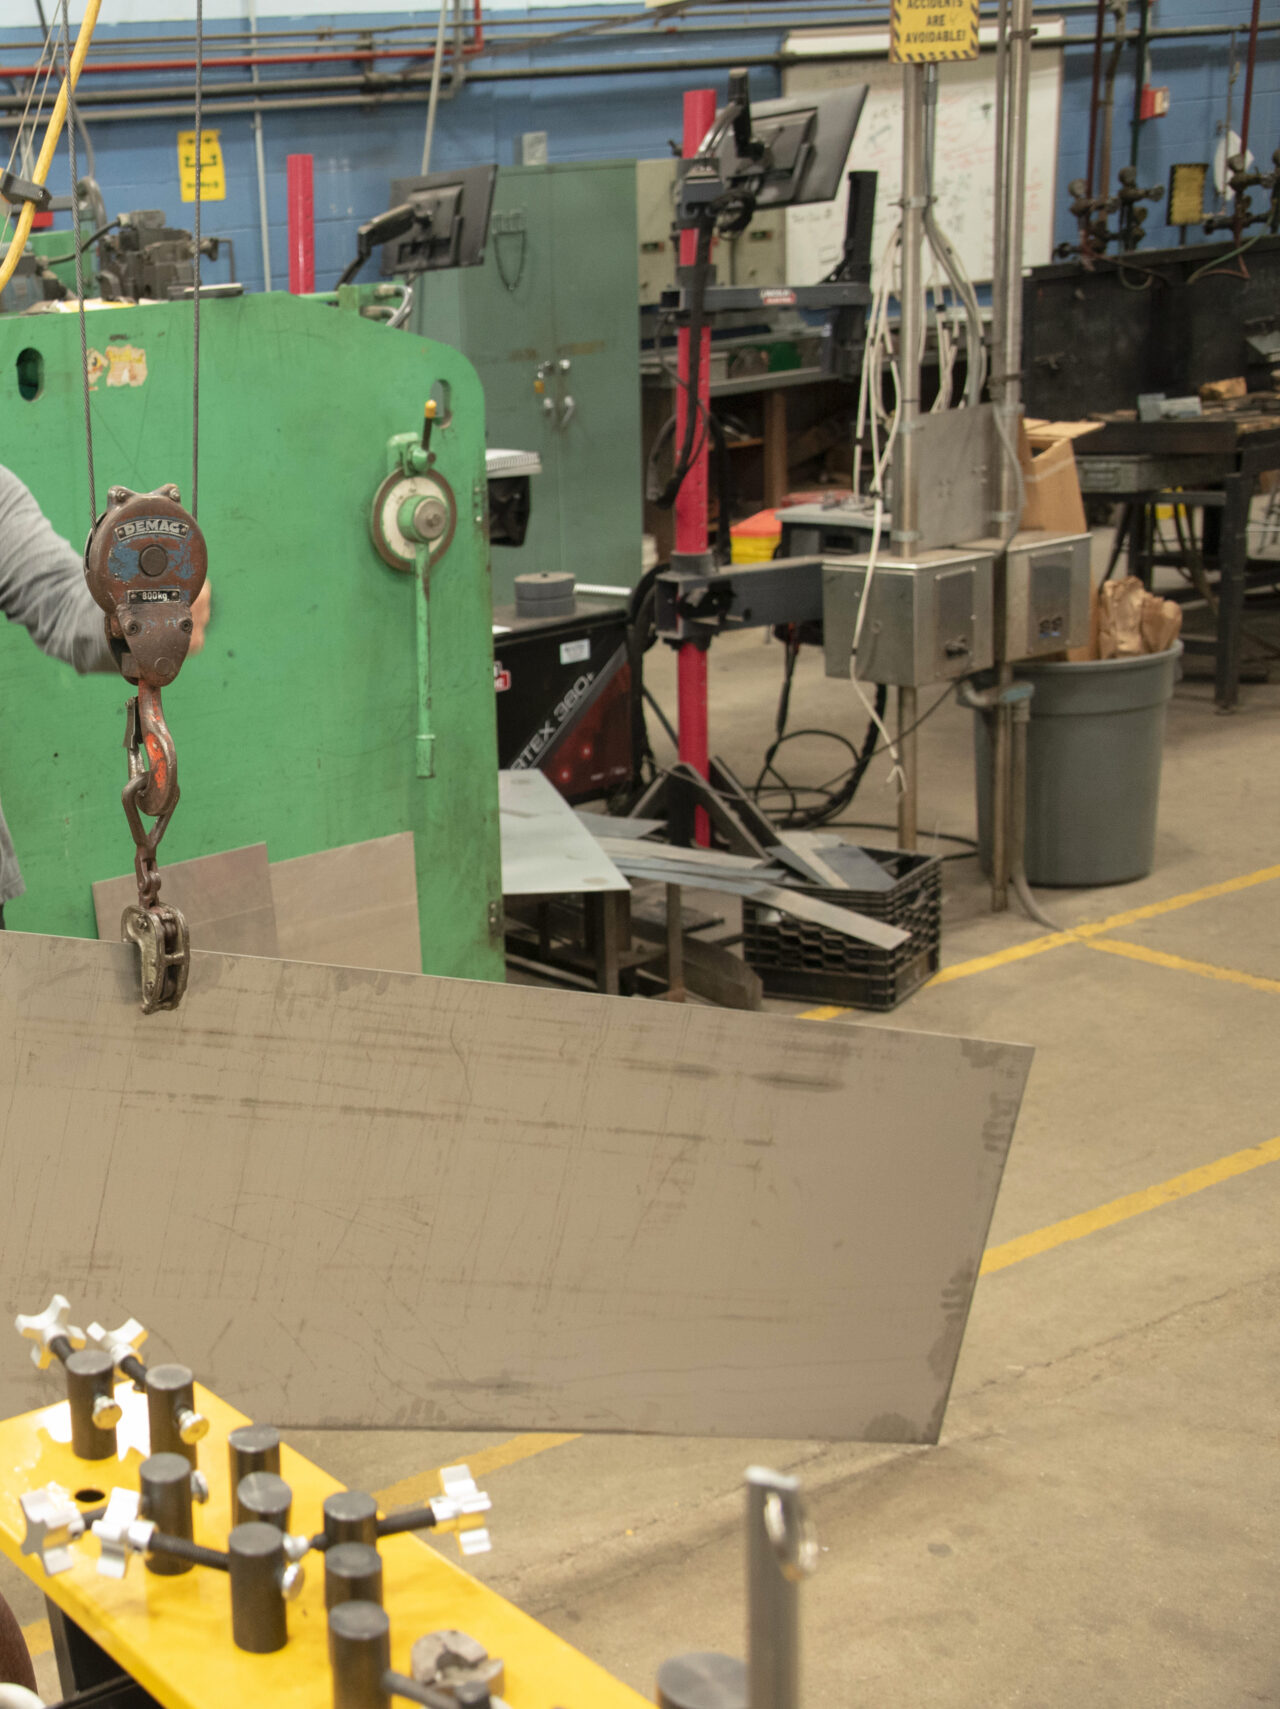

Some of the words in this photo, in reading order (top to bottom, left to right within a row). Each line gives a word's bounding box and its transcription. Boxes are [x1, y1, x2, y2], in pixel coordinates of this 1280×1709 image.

[926, 14, 945, 26] ARE
[905, 30, 966, 43] AVOIDABLE!
[123, 520, 181, 535] DEMAG
